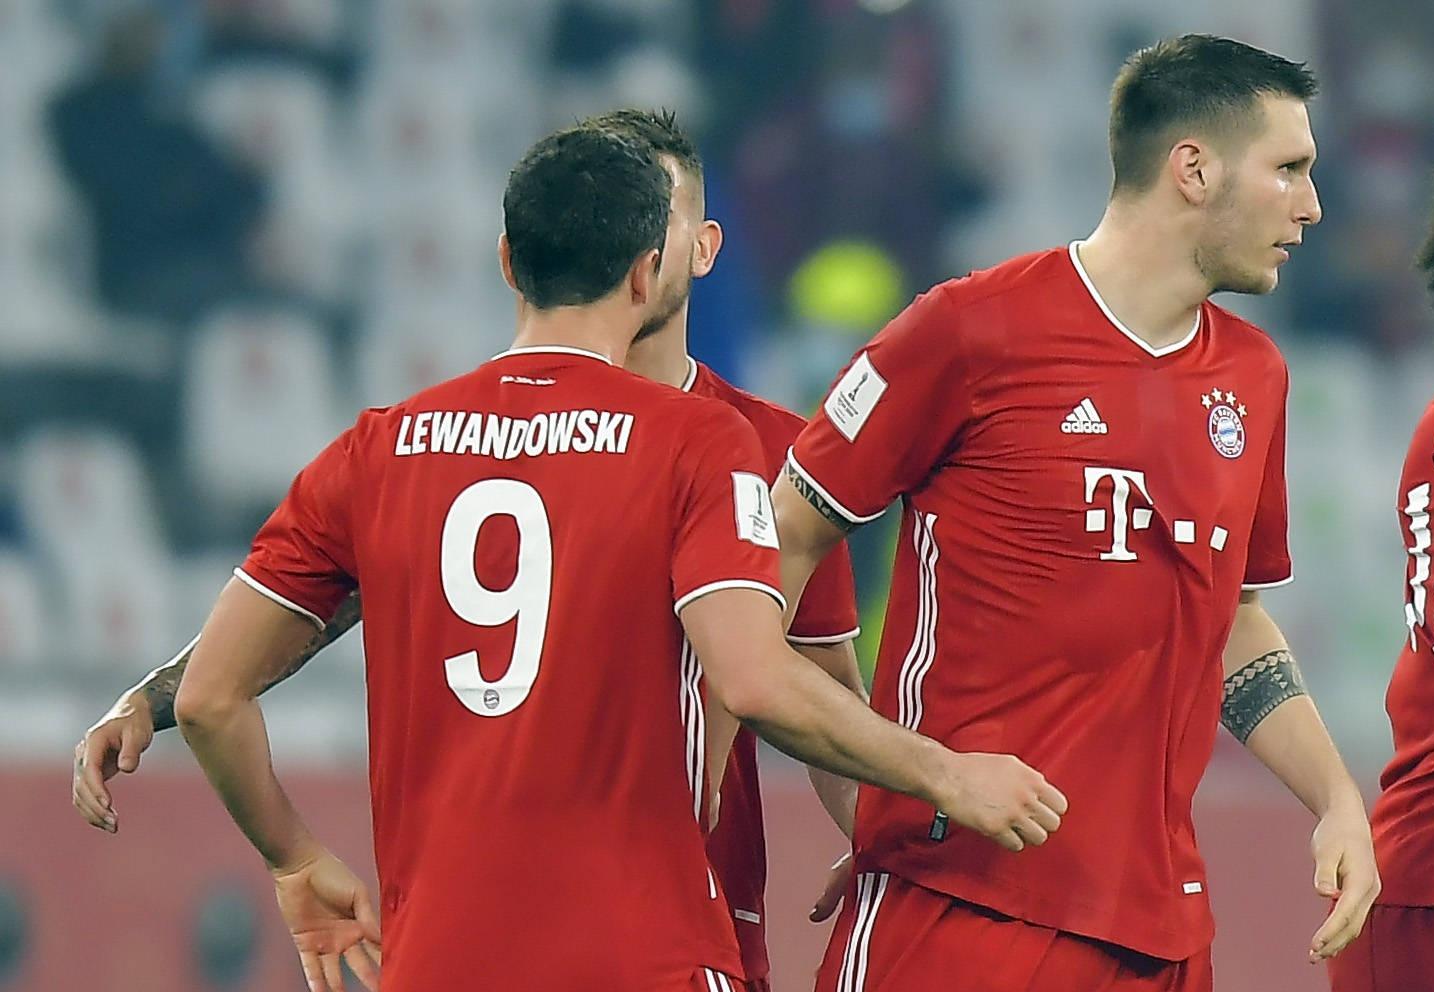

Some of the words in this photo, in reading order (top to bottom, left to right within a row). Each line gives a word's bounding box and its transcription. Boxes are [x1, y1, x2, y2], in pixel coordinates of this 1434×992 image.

[395, 409, 634, 460] LEWANDOWSKI
[1060, 419, 1108, 434] adidas
[440, 479, 552, 717] 9
